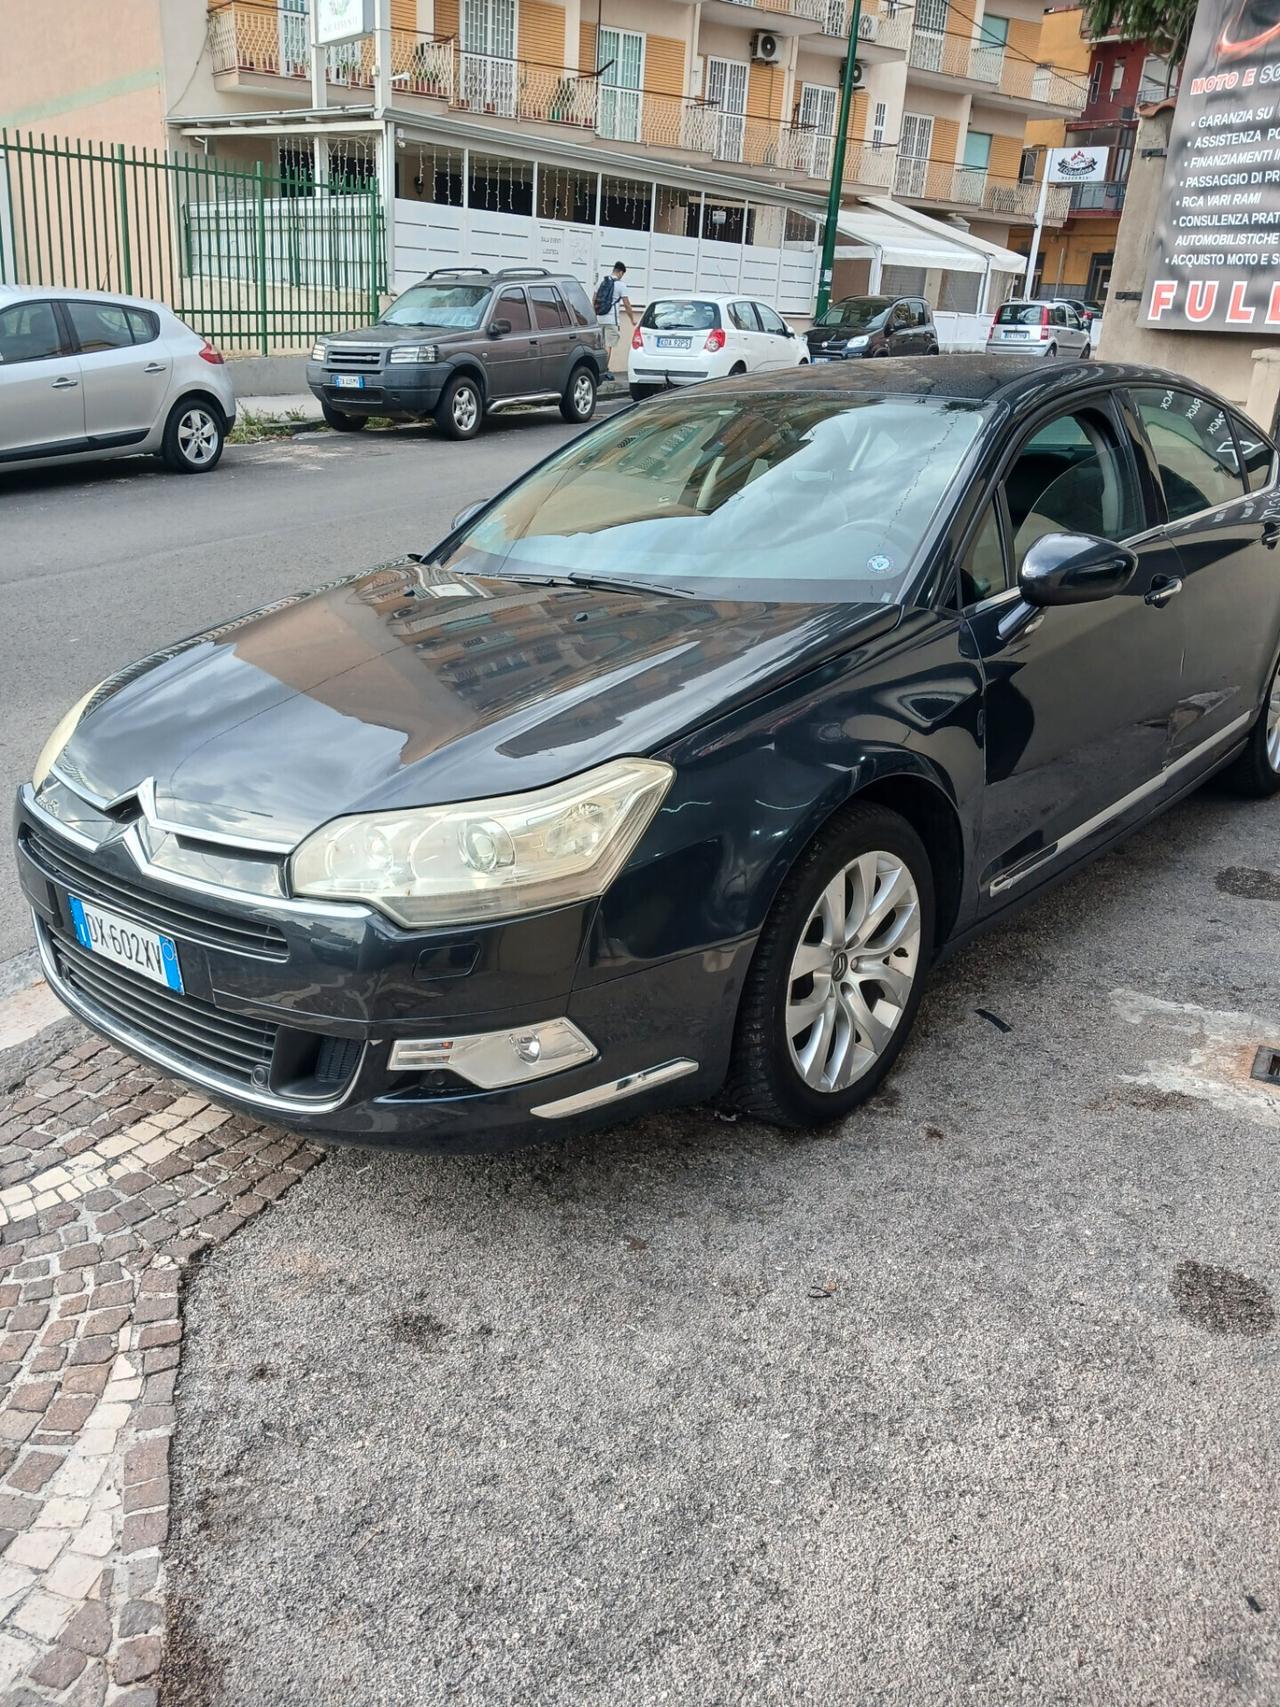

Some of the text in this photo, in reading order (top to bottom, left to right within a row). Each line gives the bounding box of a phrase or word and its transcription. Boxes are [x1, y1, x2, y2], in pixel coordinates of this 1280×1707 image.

[1190, 71, 1239, 96] MOTO
[1242, 67, 1257, 87] E
[1198, 106, 1274, 128] GARANZIA SU
[1194, 129, 1262, 149] ASSISTENZA
[1190, 149, 1274, 168] FINANZIAMENTI
[1185, 172, 1249, 188] PASSAGGIO
[1251, 171, 1262, 184] DI
[1182, 192, 1262, 208] RCA VARI RAMI
[1179, 213, 1249, 227] CONSULENZA
[1175, 232, 1280, 247] AUTOMOBILISTICHE
[1171, 252, 1280, 267] ACQUISTO MOTO E S
[85, 912, 163, 976] DX 602XV
